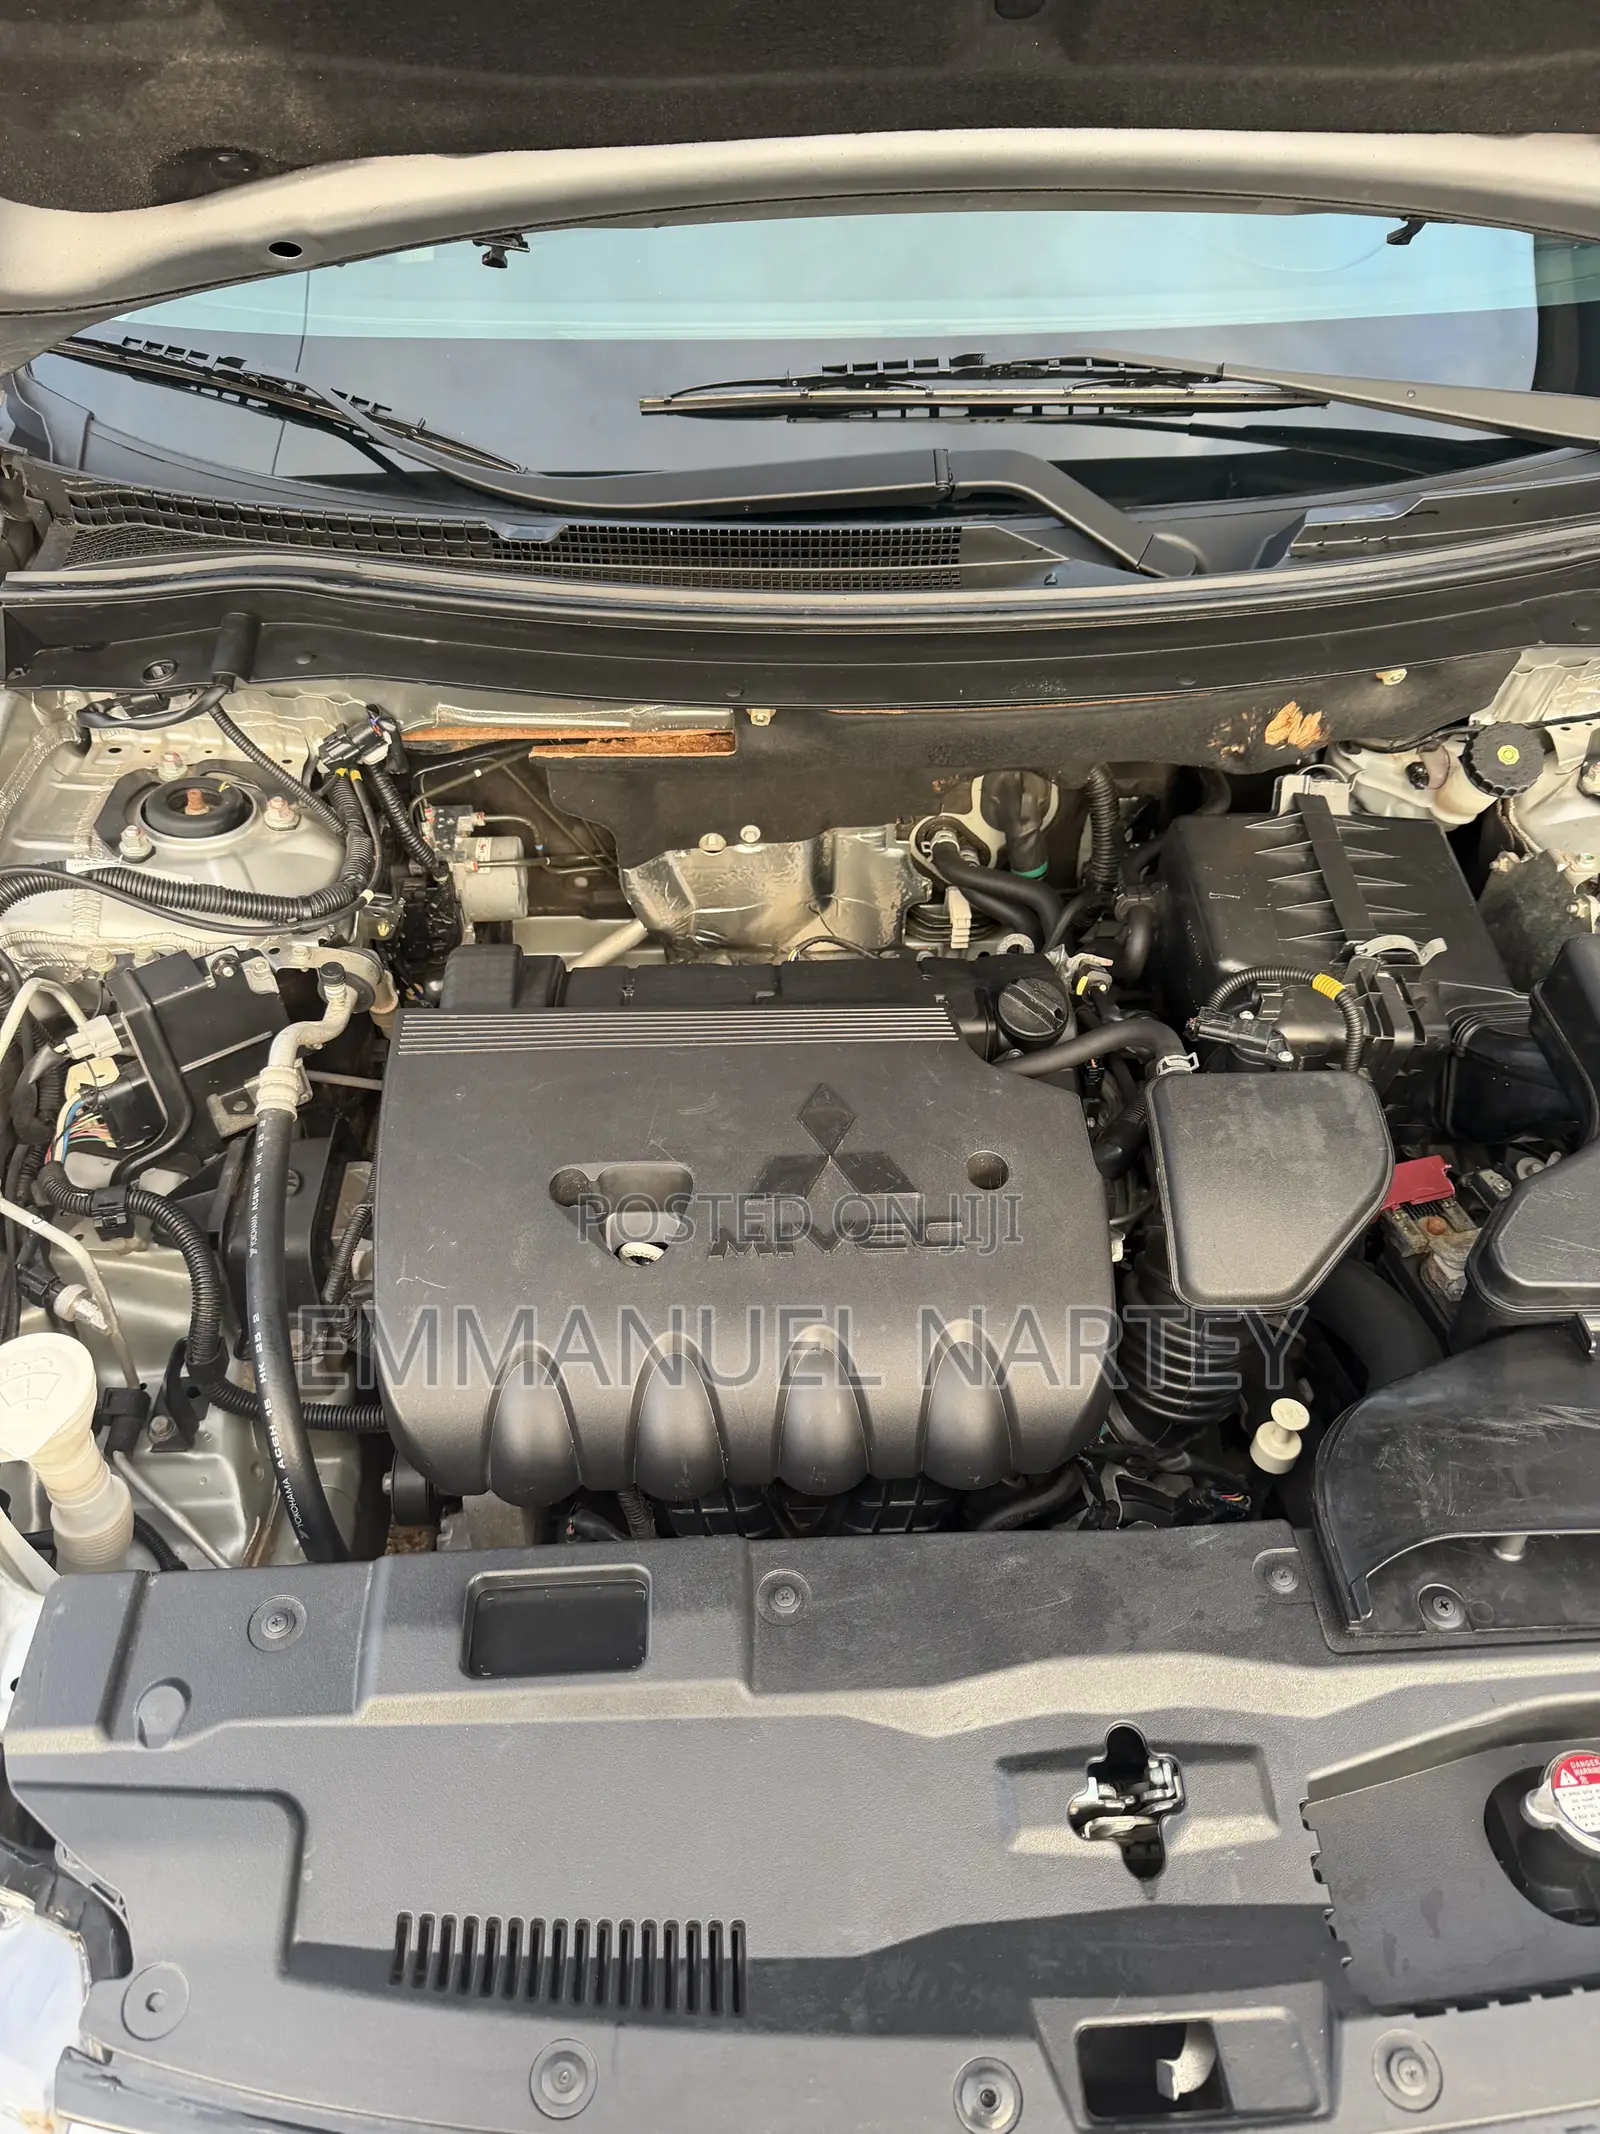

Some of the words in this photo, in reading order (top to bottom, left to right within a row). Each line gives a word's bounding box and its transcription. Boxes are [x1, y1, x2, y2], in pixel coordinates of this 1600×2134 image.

[253, 1312, 260, 1323] 2
[254, 1331, 263, 1353] 25
[258, 1361, 267, 1384] HK
[263, 1398, 273, 1417] 15
[282, 1477, 304, 1528] YOKOHAMA
